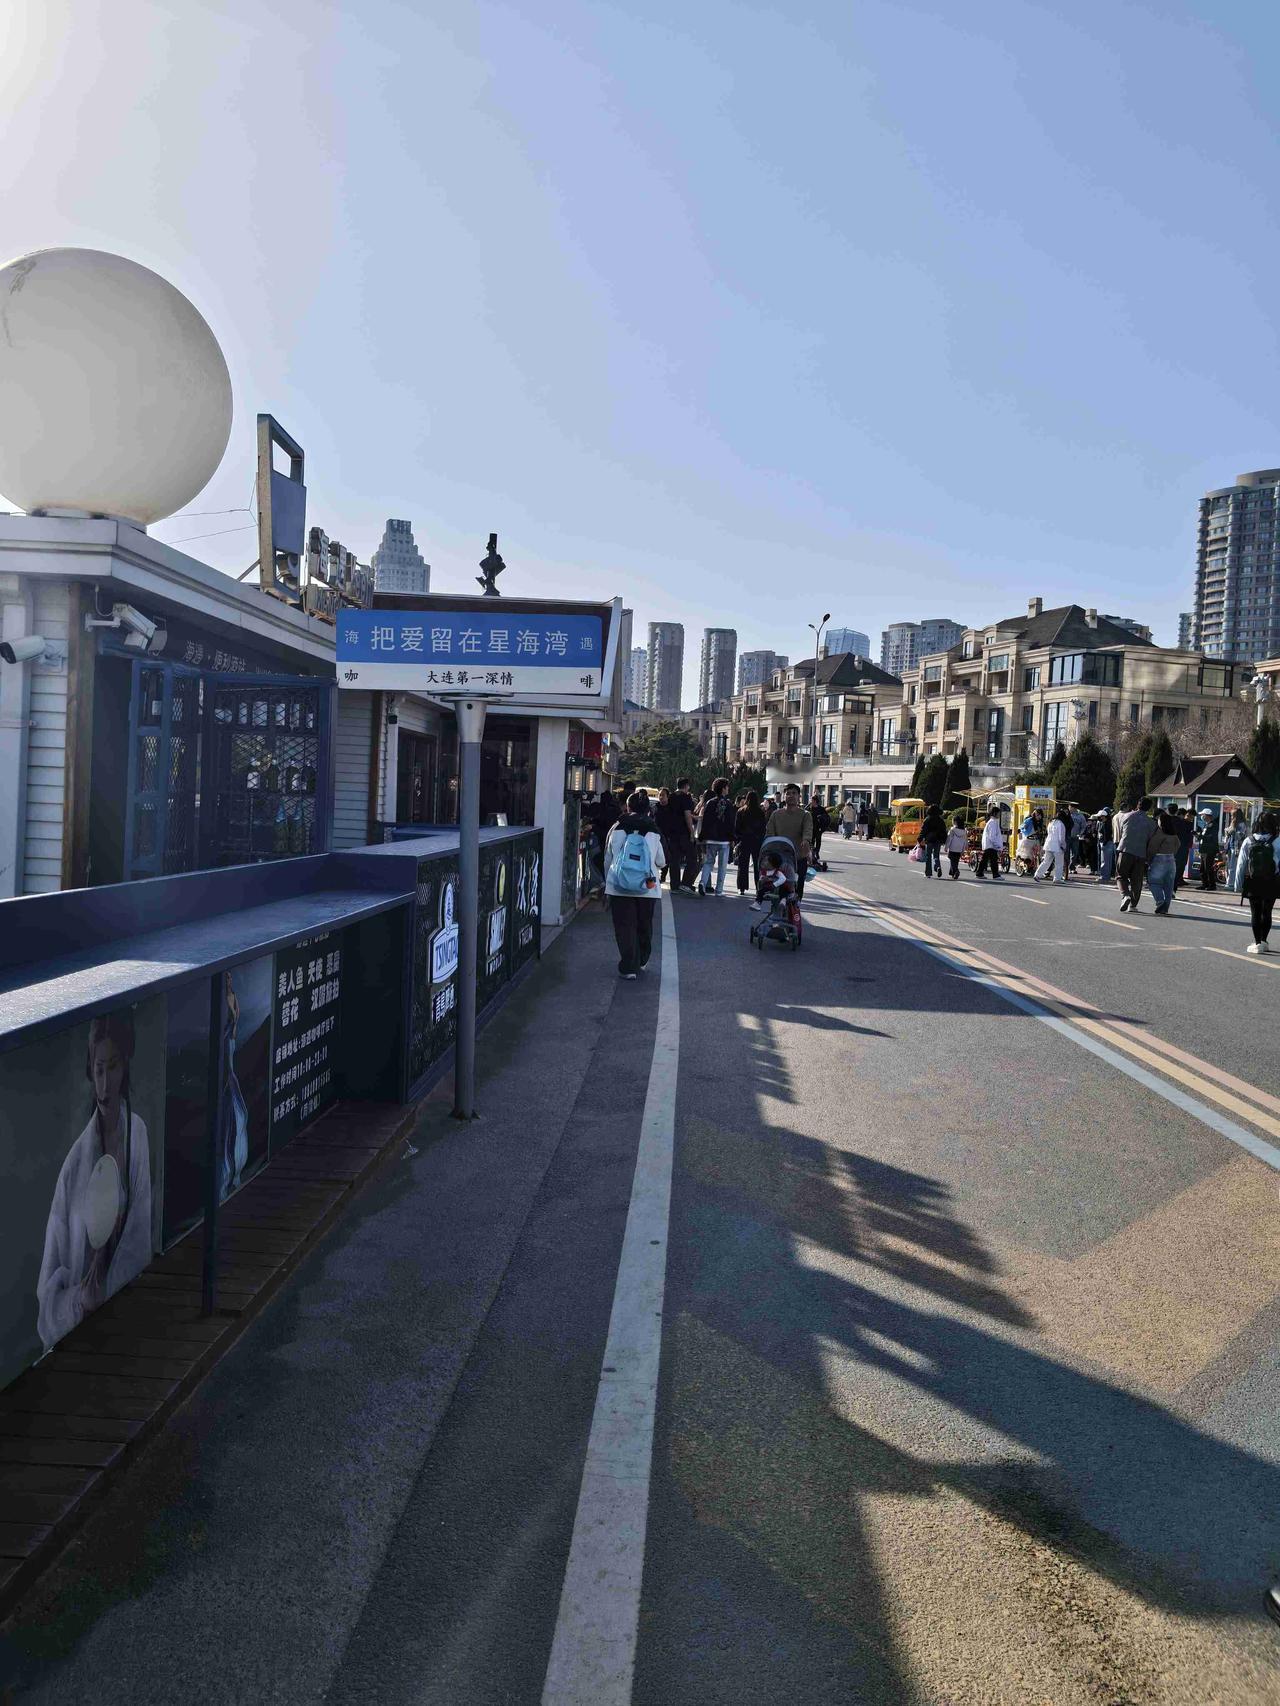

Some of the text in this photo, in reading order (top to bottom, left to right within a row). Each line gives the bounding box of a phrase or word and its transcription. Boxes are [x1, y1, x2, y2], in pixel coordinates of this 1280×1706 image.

[345, 626, 593, 656] 海 把爱留在星海湾 遇
[344, 669, 594, 689] 咖 大连第一深情 啡
[279, 966, 304, 998] 美人鱼
